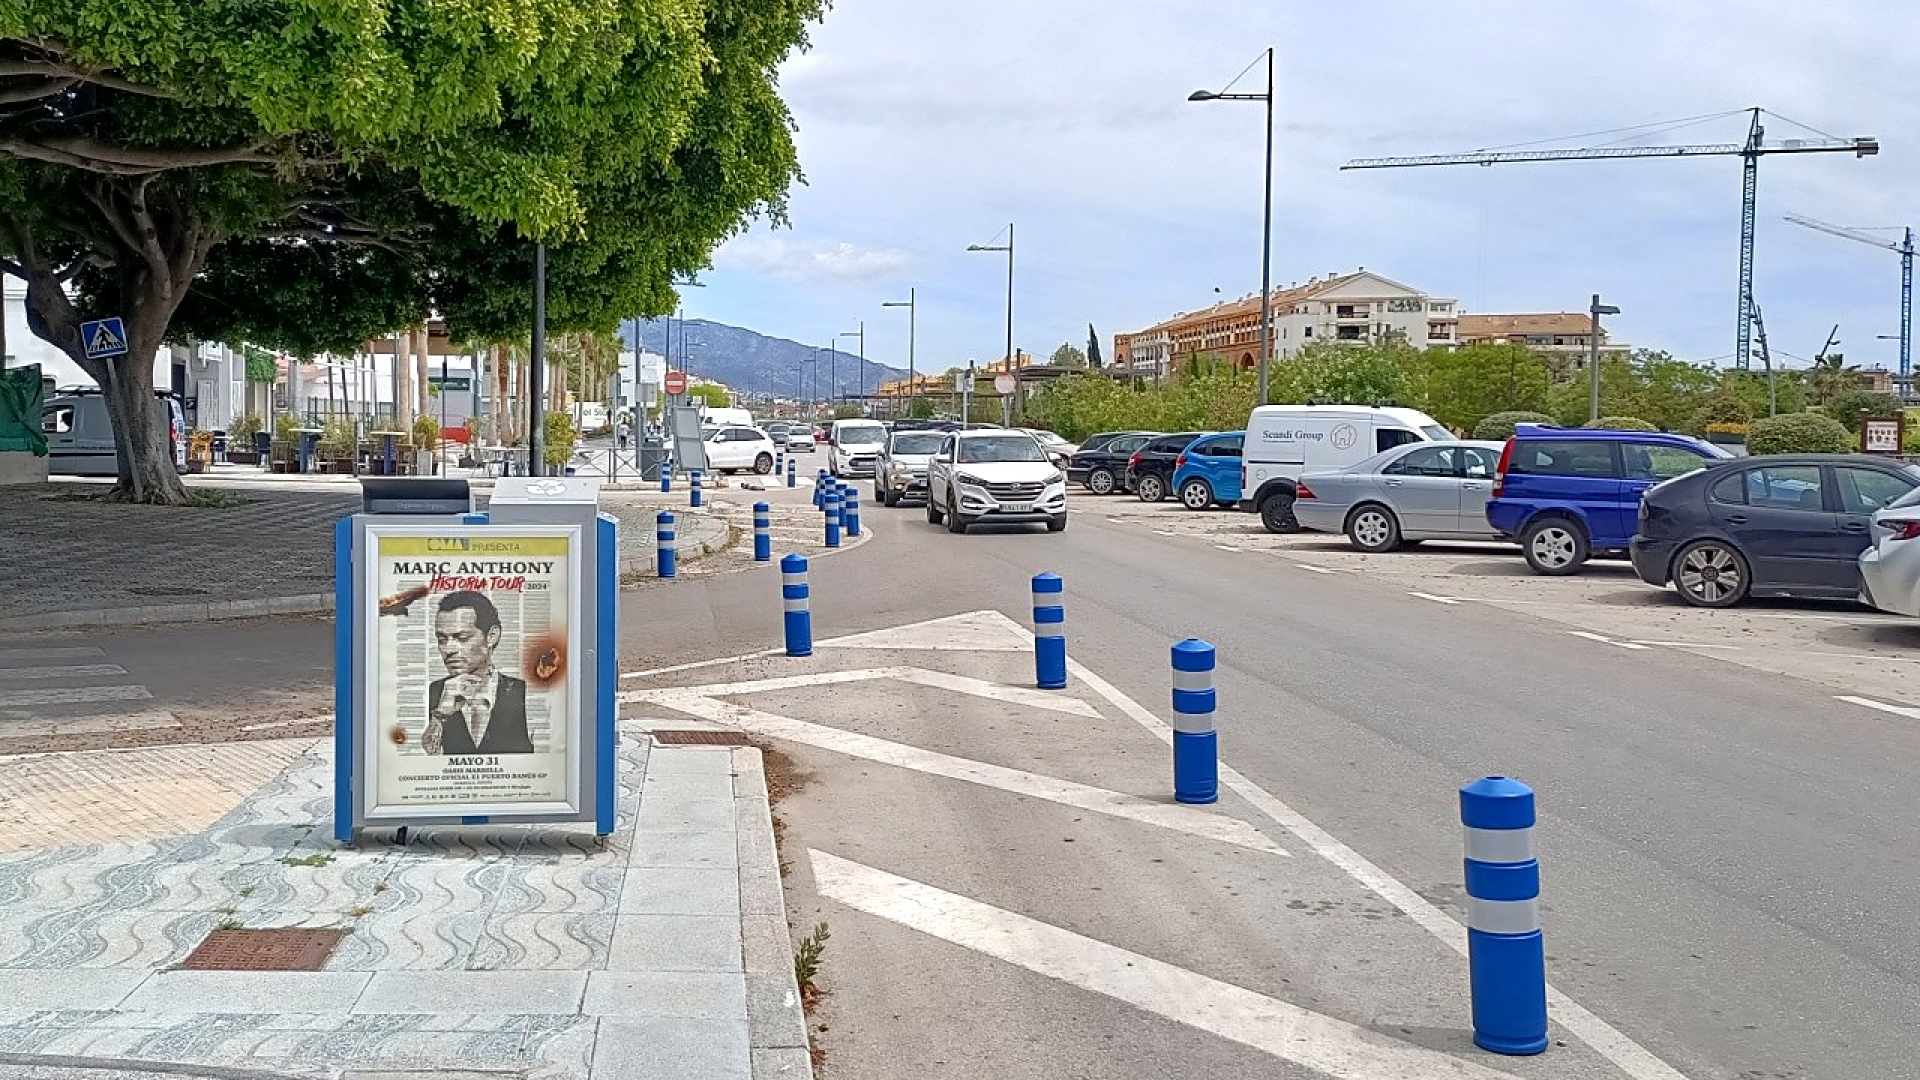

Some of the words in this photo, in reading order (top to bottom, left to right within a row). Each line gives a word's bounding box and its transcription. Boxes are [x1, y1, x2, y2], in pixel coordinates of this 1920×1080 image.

[1262, 429, 1292, 439] Scandi
[1294, 429, 1324, 442] Group
[393, 562, 452, 574] MARC
[458, 562, 555, 574] ANTHONY
[490, 576, 526, 593] TOUR
[527, 582, 548, 590] 2024
[447, 756, 484, 766] MAYO
[485, 756, 500, 766] 31
